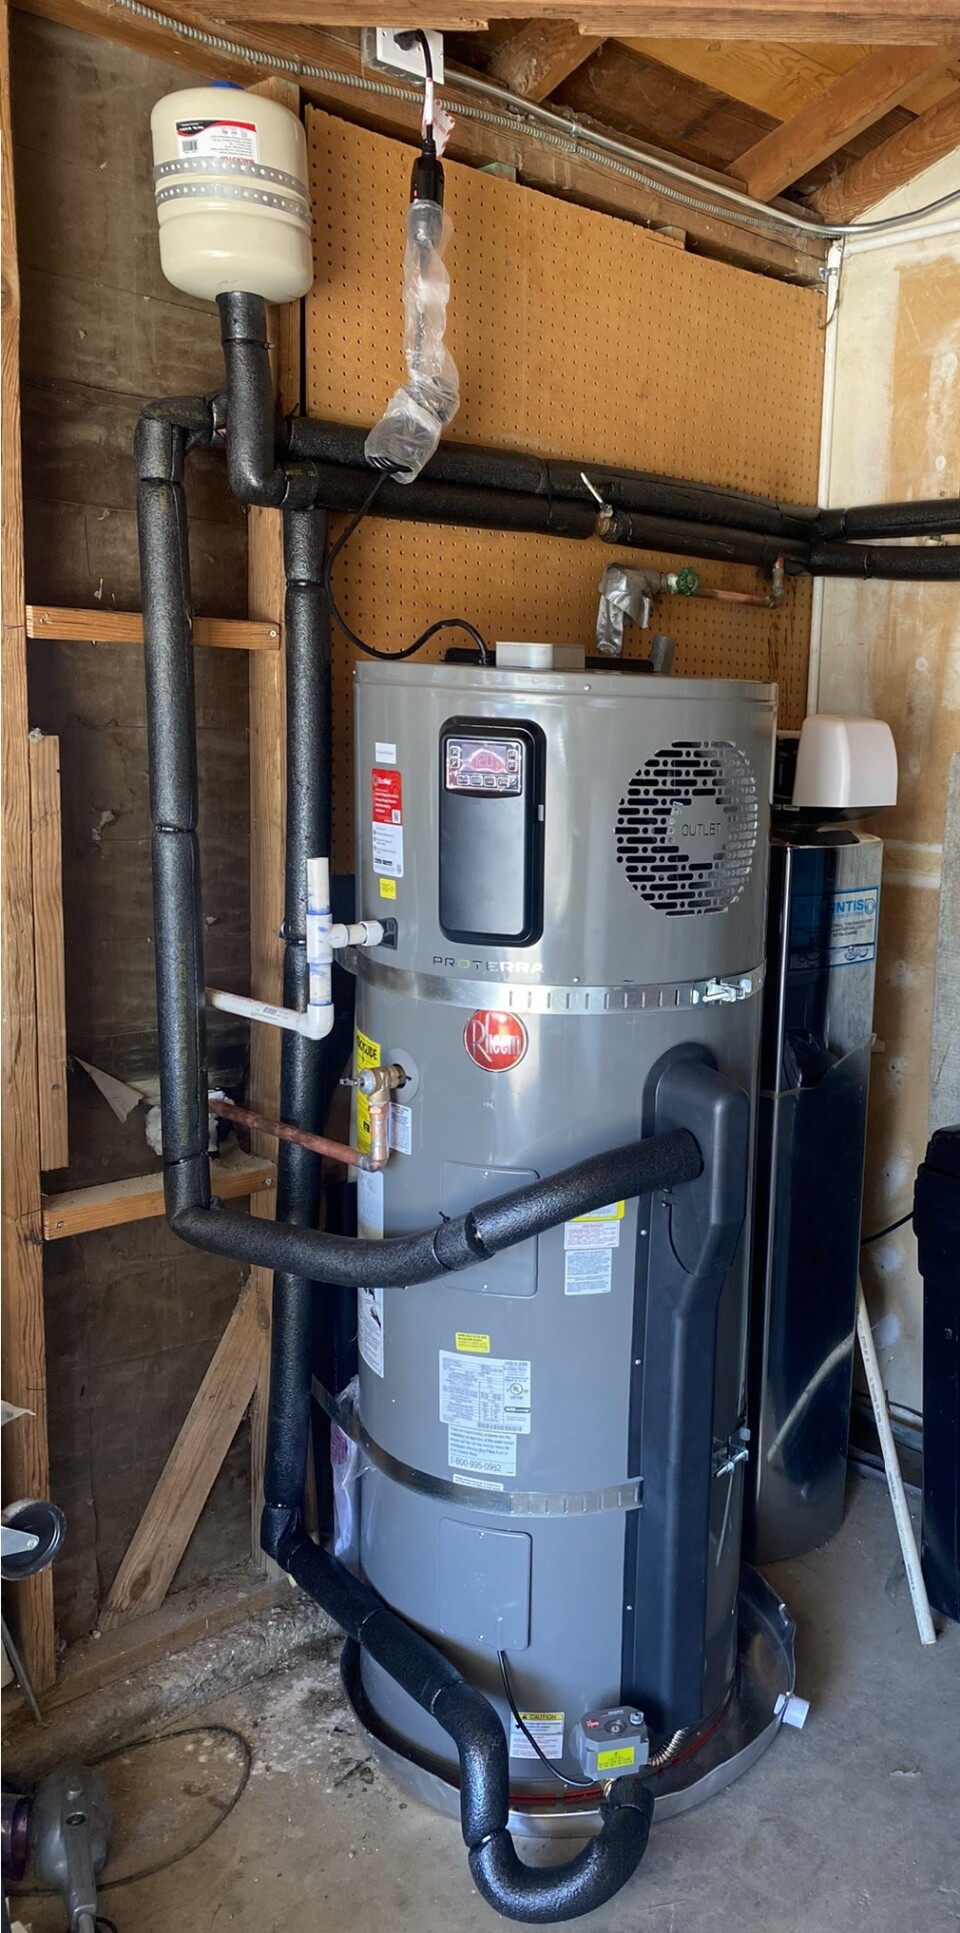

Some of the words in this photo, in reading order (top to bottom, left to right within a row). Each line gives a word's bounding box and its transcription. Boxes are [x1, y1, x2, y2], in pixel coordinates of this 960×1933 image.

[681, 823, 721, 837] OUTLET
[432, 956, 544, 974] PROTERRA
[470, 1013, 521, 1062] Rheem
